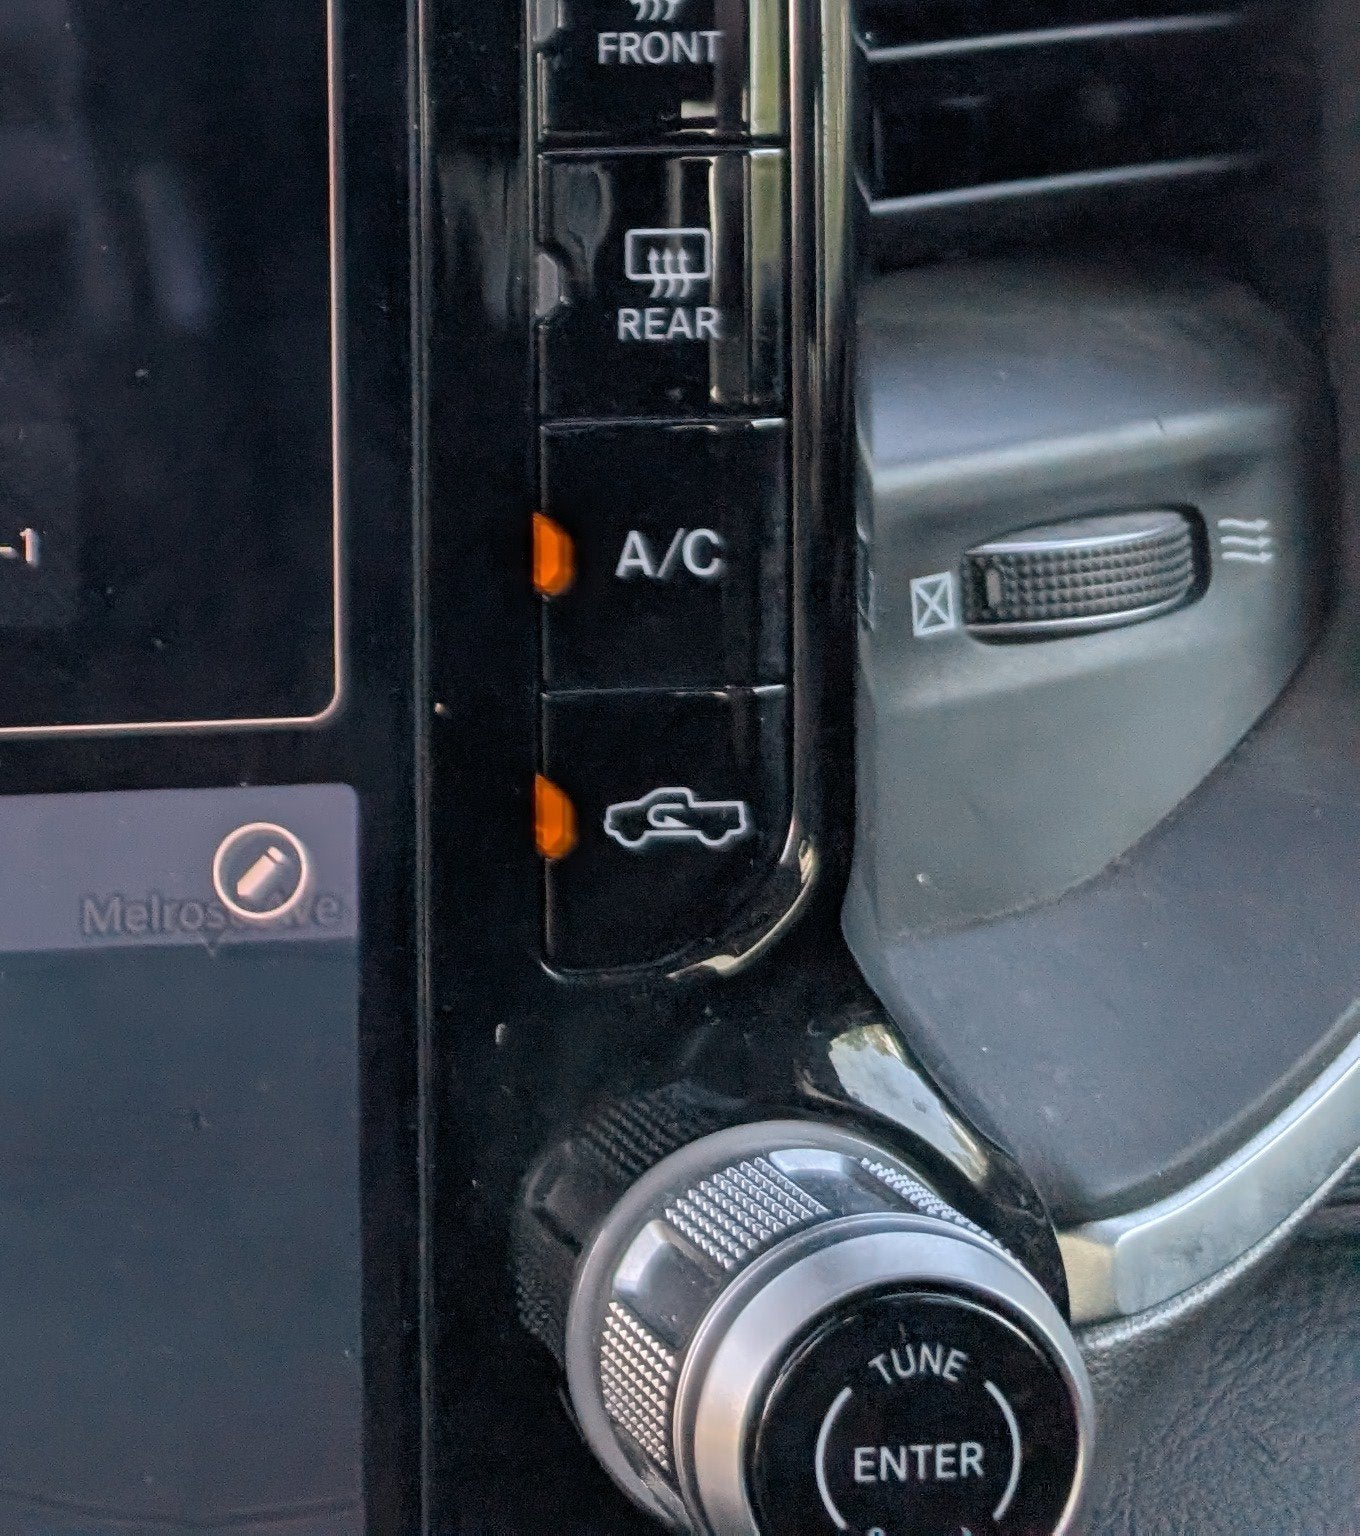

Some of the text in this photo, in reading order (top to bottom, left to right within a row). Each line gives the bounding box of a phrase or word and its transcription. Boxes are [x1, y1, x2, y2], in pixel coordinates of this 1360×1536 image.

[597, 29, 724, 66] FRONT
[617, 306, 720, 342] REAR
[614, 528, 726, 580] A/C
[81, 894, 240, 936] Melros
[868, 1342, 970, 1388] TUNE
[853, 1441, 985, 1484] ENTER
